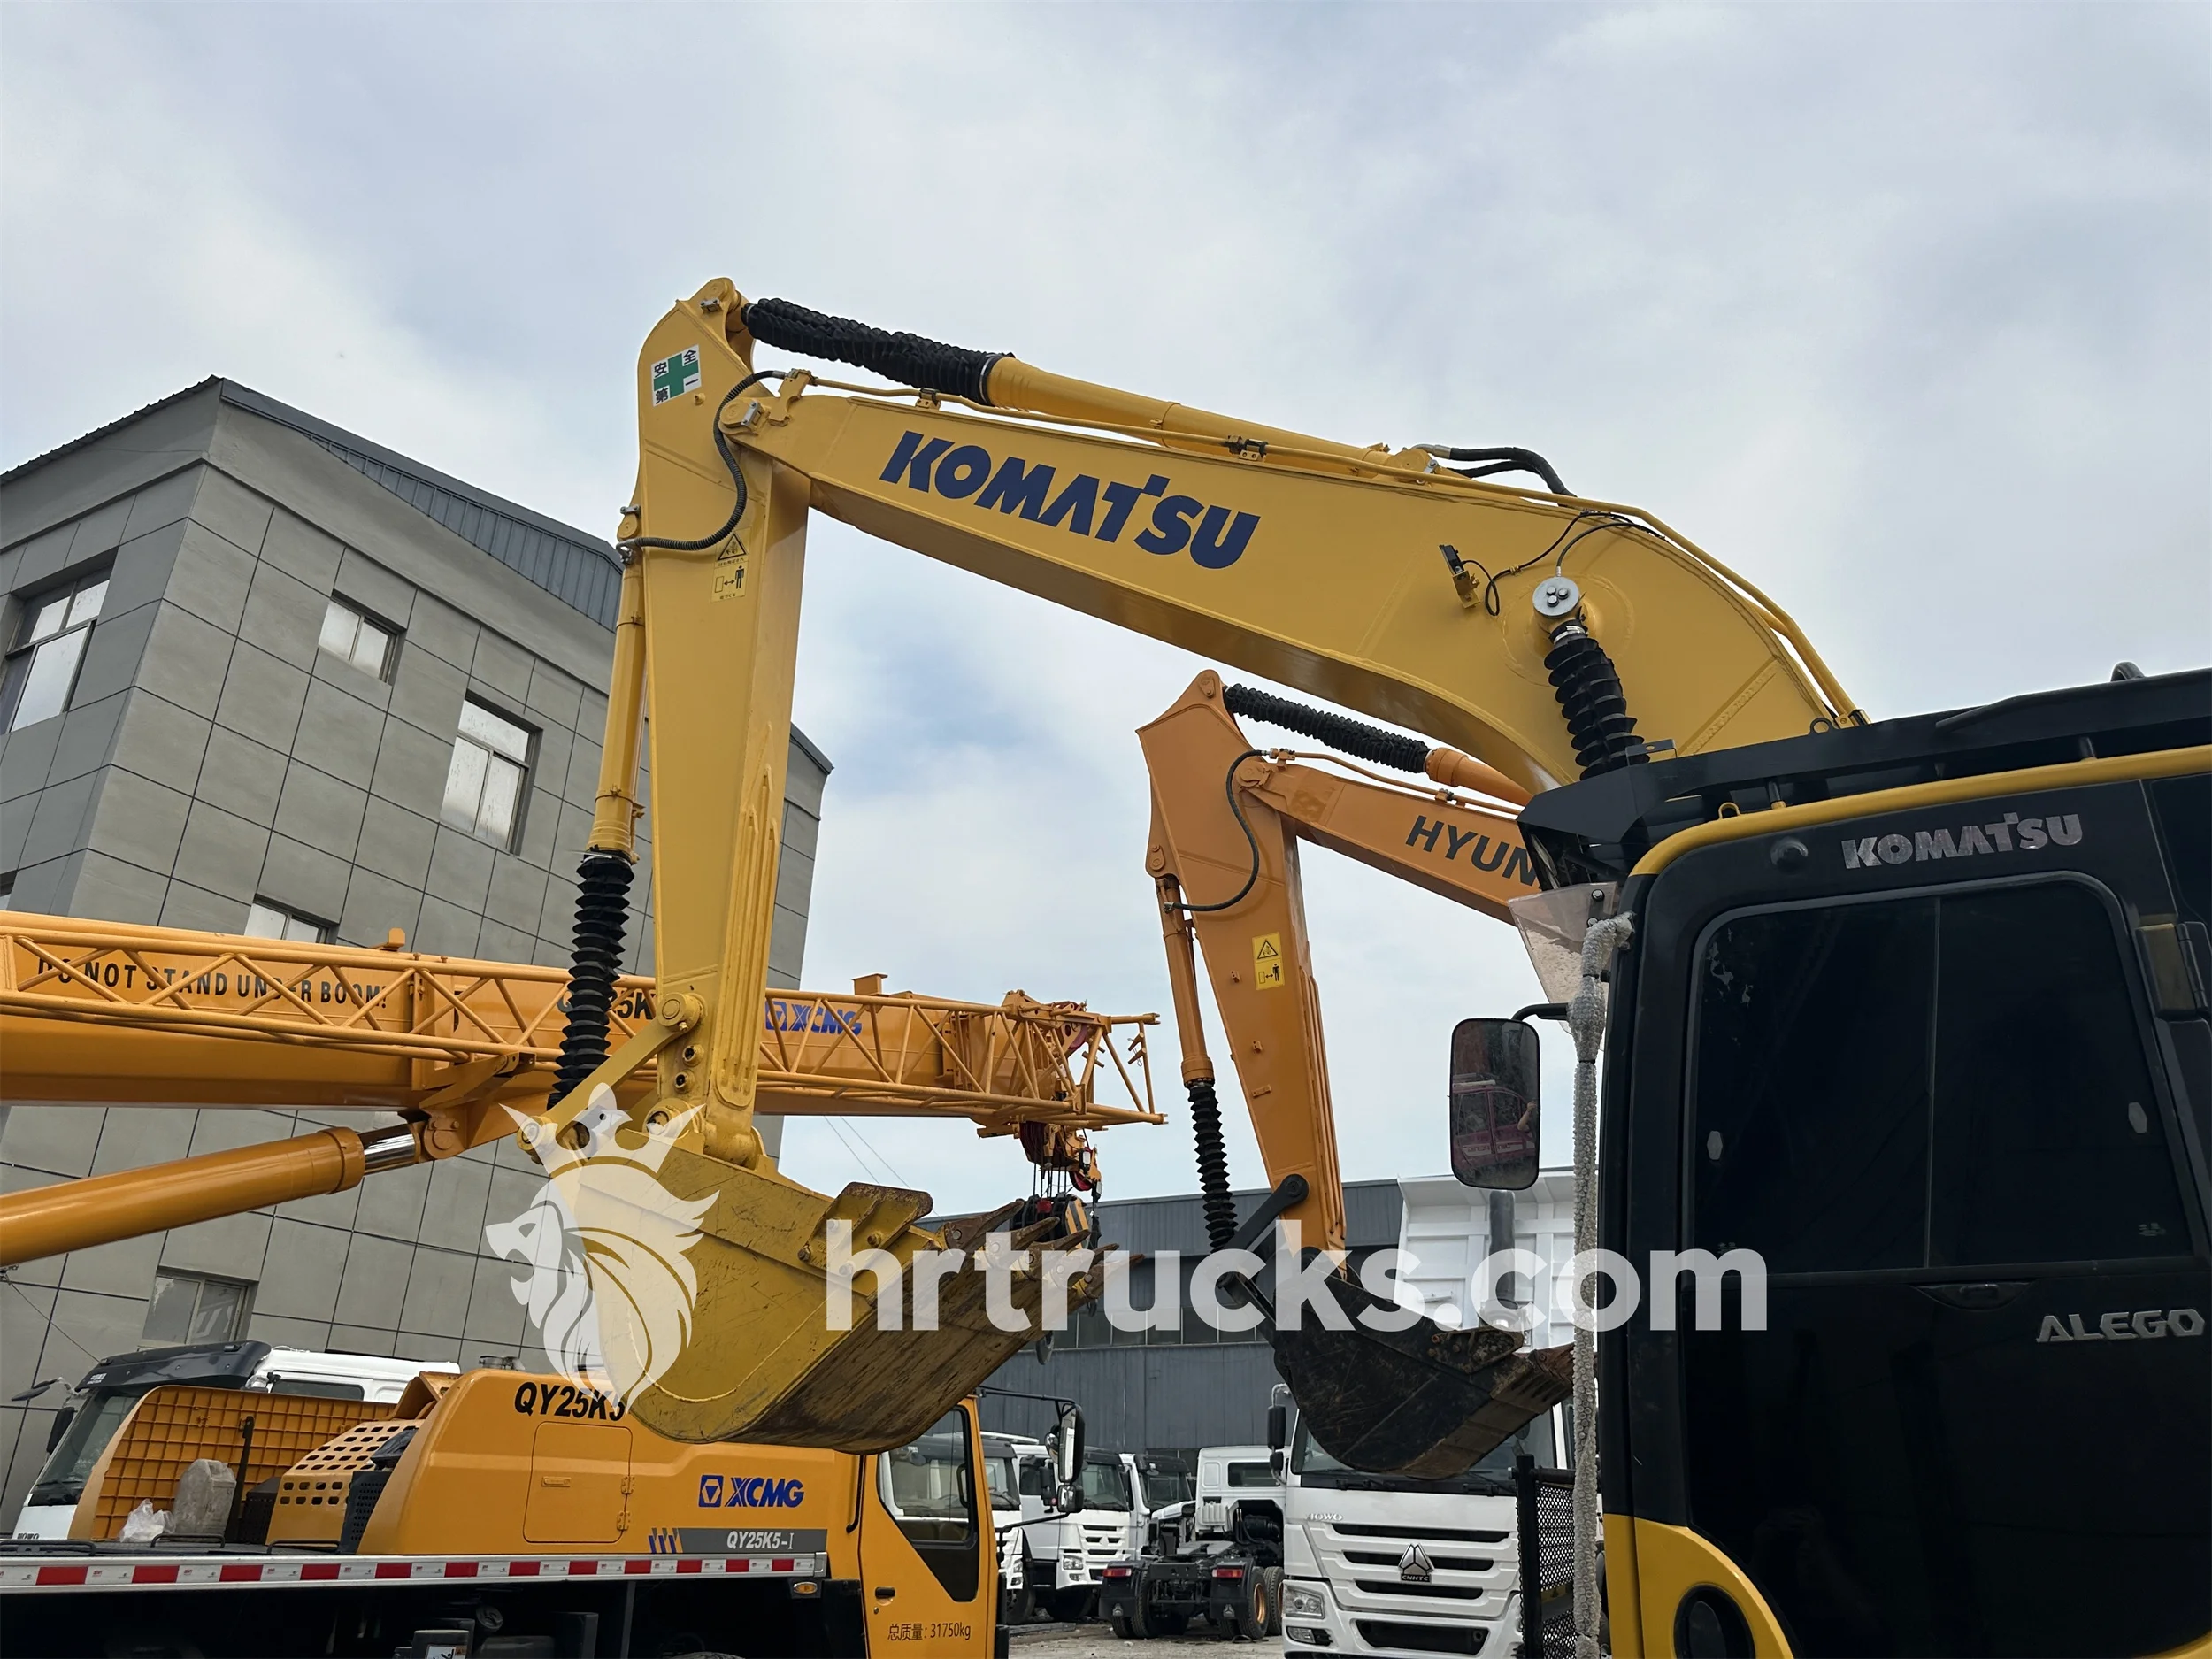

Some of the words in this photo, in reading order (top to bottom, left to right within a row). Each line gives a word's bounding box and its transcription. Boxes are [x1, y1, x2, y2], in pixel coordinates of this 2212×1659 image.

[654, 361, 667, 378] 安
[683, 349, 696, 365] 全
[879, 430, 1262, 570] KOMATSU
[1841, 811, 2083, 869] KOMATSU
[84, 961, 136, 988] NOT
[788, 1003, 863, 1036] XCMG
[2035, 1308, 2206, 1343] ALEGO
[724, 1477, 804, 1508] XCMG
